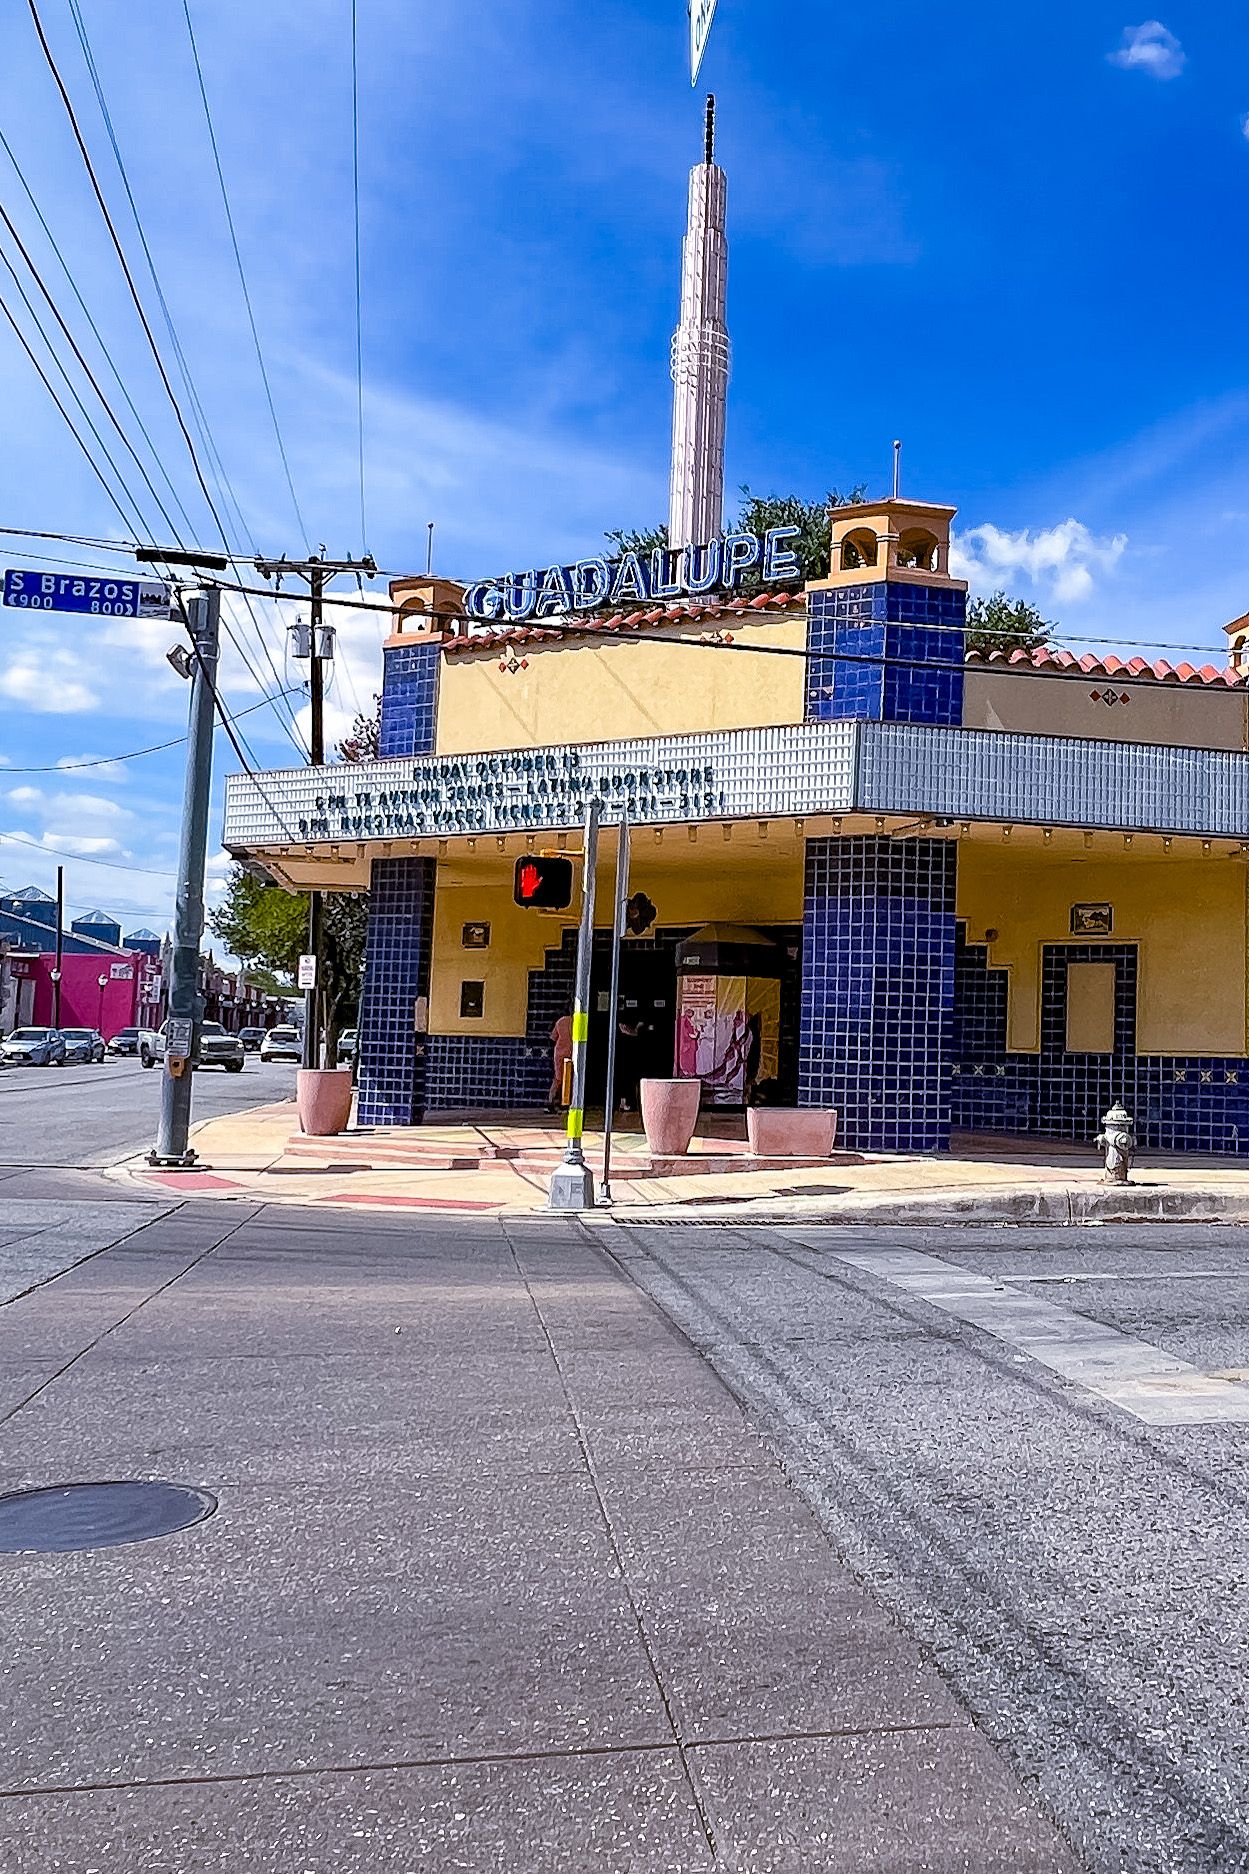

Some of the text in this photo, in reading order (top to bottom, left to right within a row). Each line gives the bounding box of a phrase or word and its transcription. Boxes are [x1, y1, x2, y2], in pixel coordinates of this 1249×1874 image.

[10, 572, 133, 600] S Brazos
[463, 525, 802, 619] GUADALUPE
[413, 762, 469, 781] FRIDAY
[475, 754, 557, 776] OCTOBER
[378, 786, 441, 805] AUTHOR
[446, 781, 504, 801] SERIES
[599, 766, 713, 793] BOOKSTORE
[340, 811, 426, 831] NUESTRAS
[432, 808, 484, 825] VOCES
[493, 801, 567, 821] TICKETS
